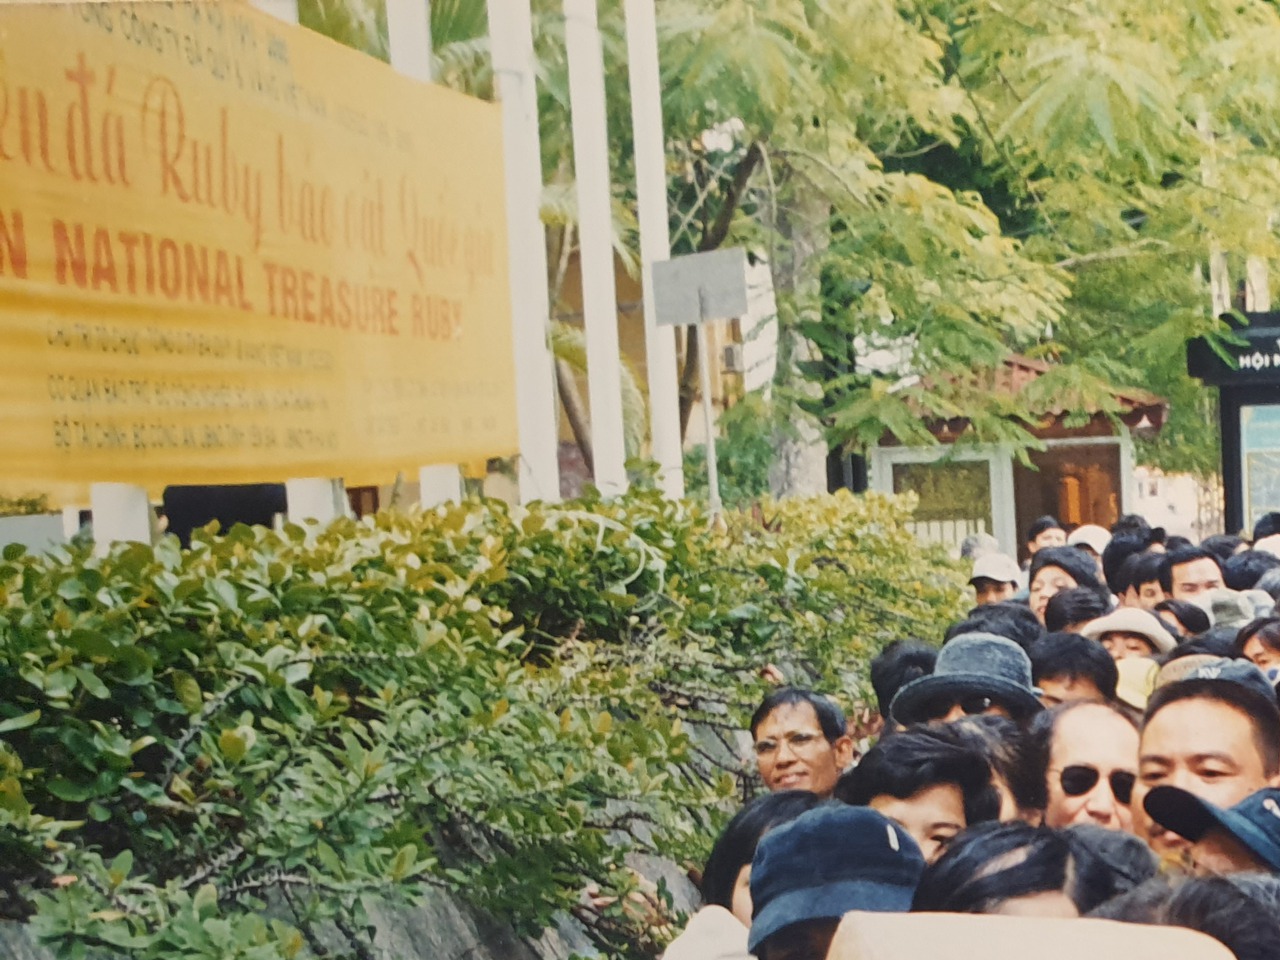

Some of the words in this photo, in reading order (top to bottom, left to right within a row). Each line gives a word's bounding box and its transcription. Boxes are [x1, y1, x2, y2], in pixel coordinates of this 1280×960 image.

[141, 73, 263, 253] Ruby
[53, 218, 254, 312] NATIONAL
[263, 261, 400, 337] TREASURE
[411, 293, 463, 342] RUBY
[1239, 351, 1270, 370] HỘI
